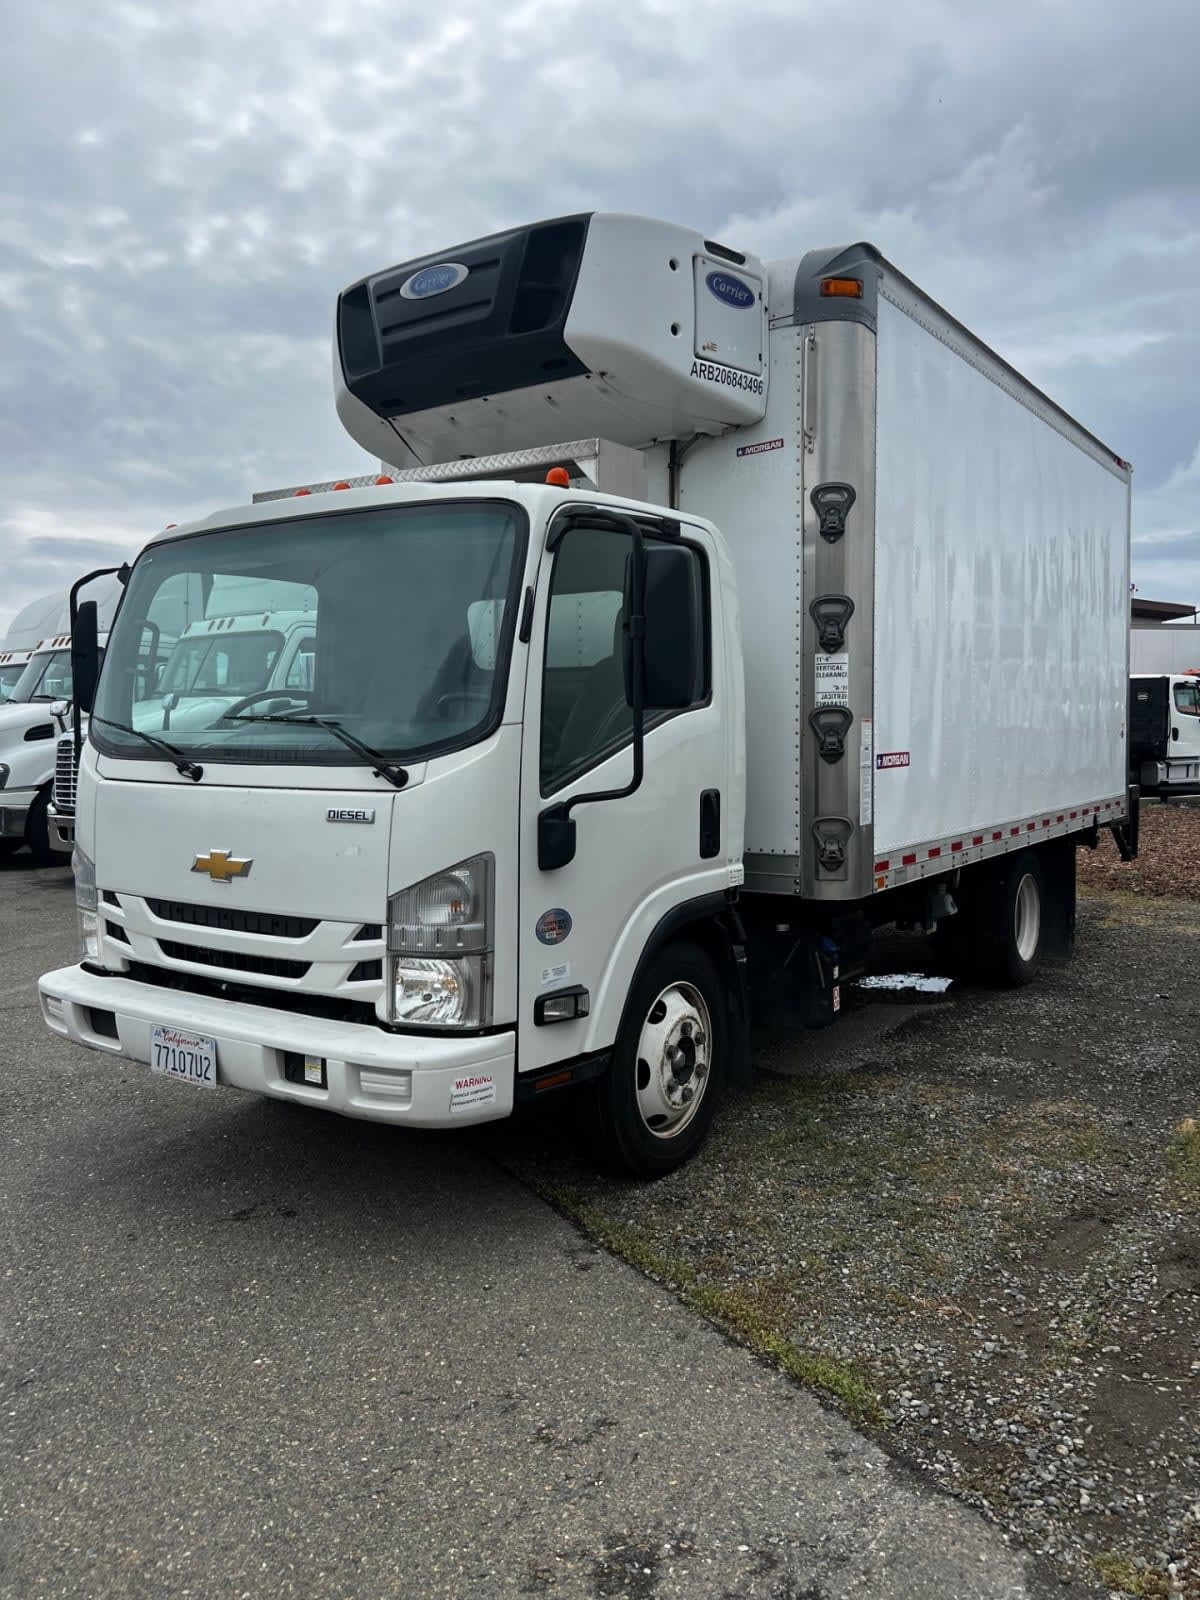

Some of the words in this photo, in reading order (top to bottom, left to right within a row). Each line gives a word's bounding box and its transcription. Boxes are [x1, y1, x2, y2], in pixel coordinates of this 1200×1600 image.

[712, 277, 750, 301] Carrier
[690, 361, 764, 395] ARB206843496
[745, 440, 782, 455] MORGAN
[882, 753, 909, 767] MORGAN
[327, 809, 369, 821] DIESEL
[163, 1028, 204, 1049] California
[154, 1043, 211, 1081] 77107U2
